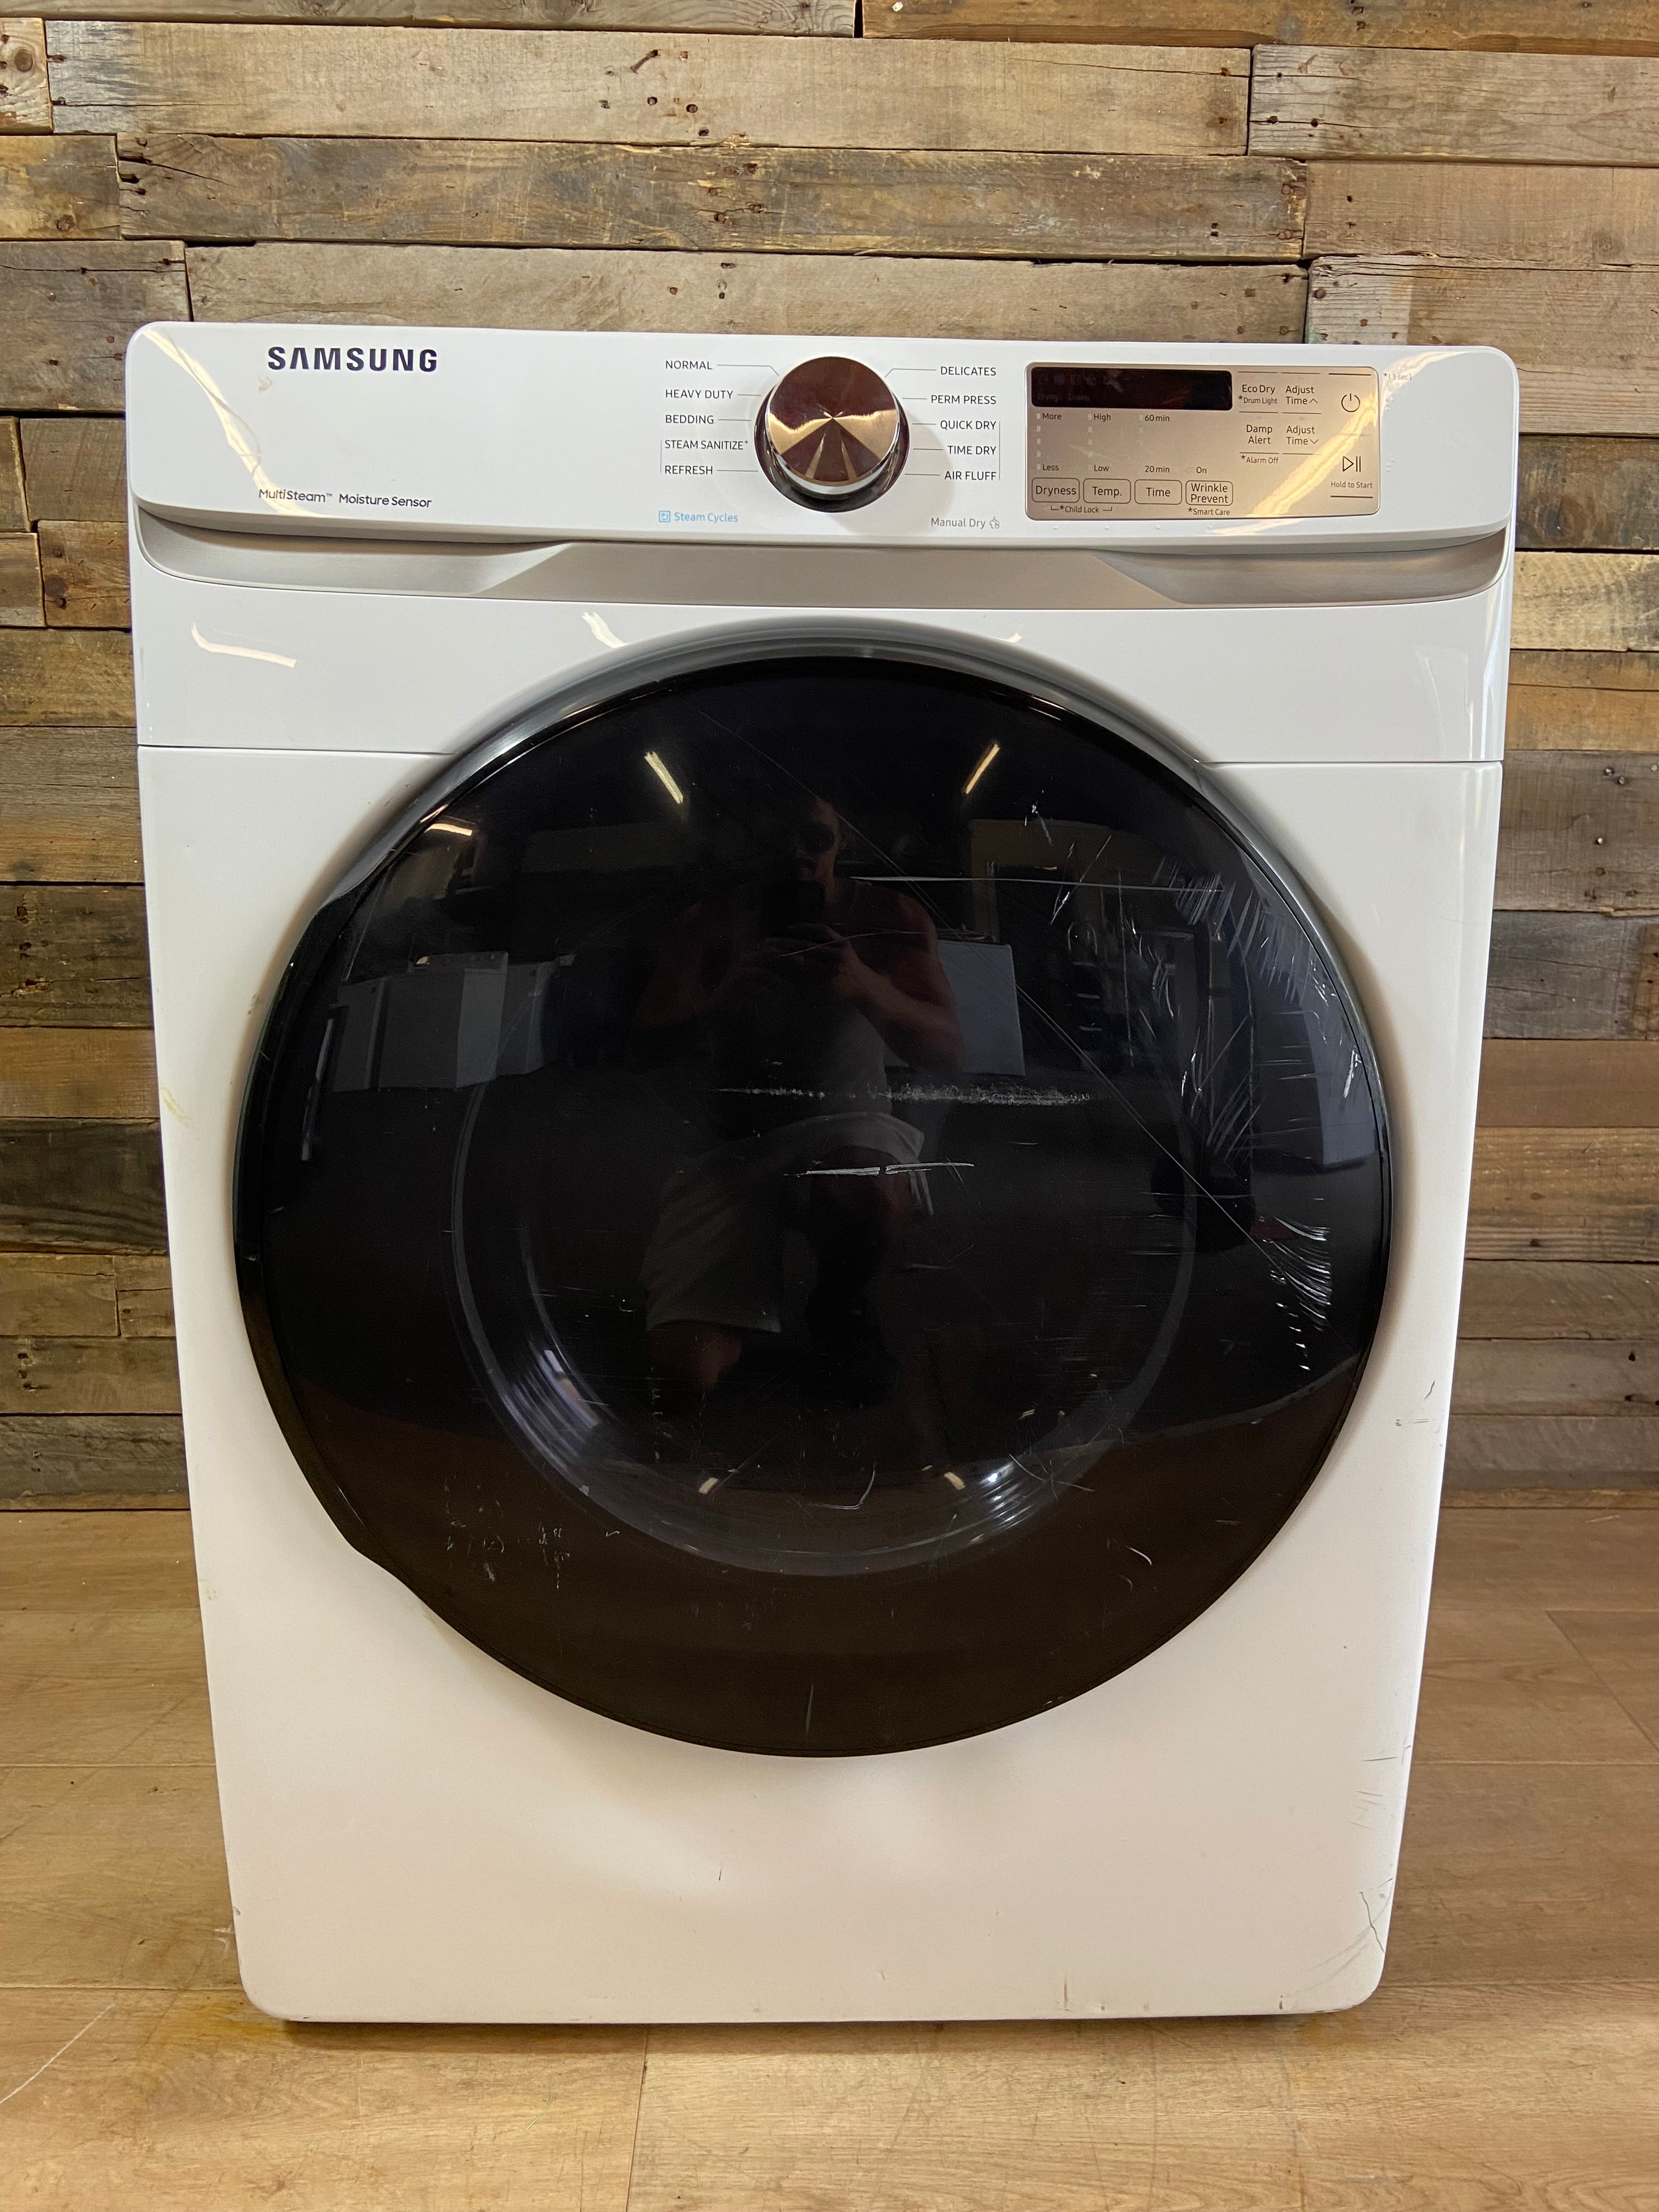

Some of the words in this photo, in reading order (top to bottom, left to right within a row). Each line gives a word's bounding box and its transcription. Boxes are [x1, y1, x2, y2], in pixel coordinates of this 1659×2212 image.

[268, 346, 438, 372] SAMSUNG
[665, 360, 713, 370] NORMAL
[940, 366, 997, 376] DELICATES
[665, 389, 702, 399] HEAVY
[704, 390, 733, 399] DUTY
[1242, 384, 1258, 393] Eco
[1259, 385, 1276, 394] Dry
[1285, 386, 1315, 395] Adjust
[930, 394, 961, 404] PERM
[963, 395, 997, 405] PRESS
[1262, 397, 1278, 406] Light
[1285, 397, 1308, 405] Time
[665, 414, 714, 424] BEDDING
[1042, 413, 1062, 421] More
[1093, 414, 1111, 422] High
[940, 420, 973, 431] QUICK
[975, 421, 997, 430] DRY
[1246, 424, 1273, 435] Damp
[1286, 426, 1316, 435] Adjust
[664, 439, 699, 449] STEAM
[1248, 436, 1272, 444] Alert
[1286, 437, 1309, 445] Time
[947, 445, 973, 455] TIME
[975, 446, 997, 455] DRY
[664, 465, 713, 475] REFRESH
[944, 471, 962, 481] AIR
[965, 471, 997, 481] FLUFF
[1035, 486, 1077, 496] Dryness
[1092, 486, 1122, 498] Temp.
[1146, 487, 1171, 497] Time
[1190, 483, 1228, 493] Wrinkle
[338, 493, 390, 506] Moisture
[391, 496, 432, 509] Sensor
[1190, 494, 1229, 504] Prevent
[674, 512, 706, 521] Steam
[707, 512, 738, 524] Cycles
[931, 517, 966, 527] Manual
[969, 518, 986, 530] Dry
